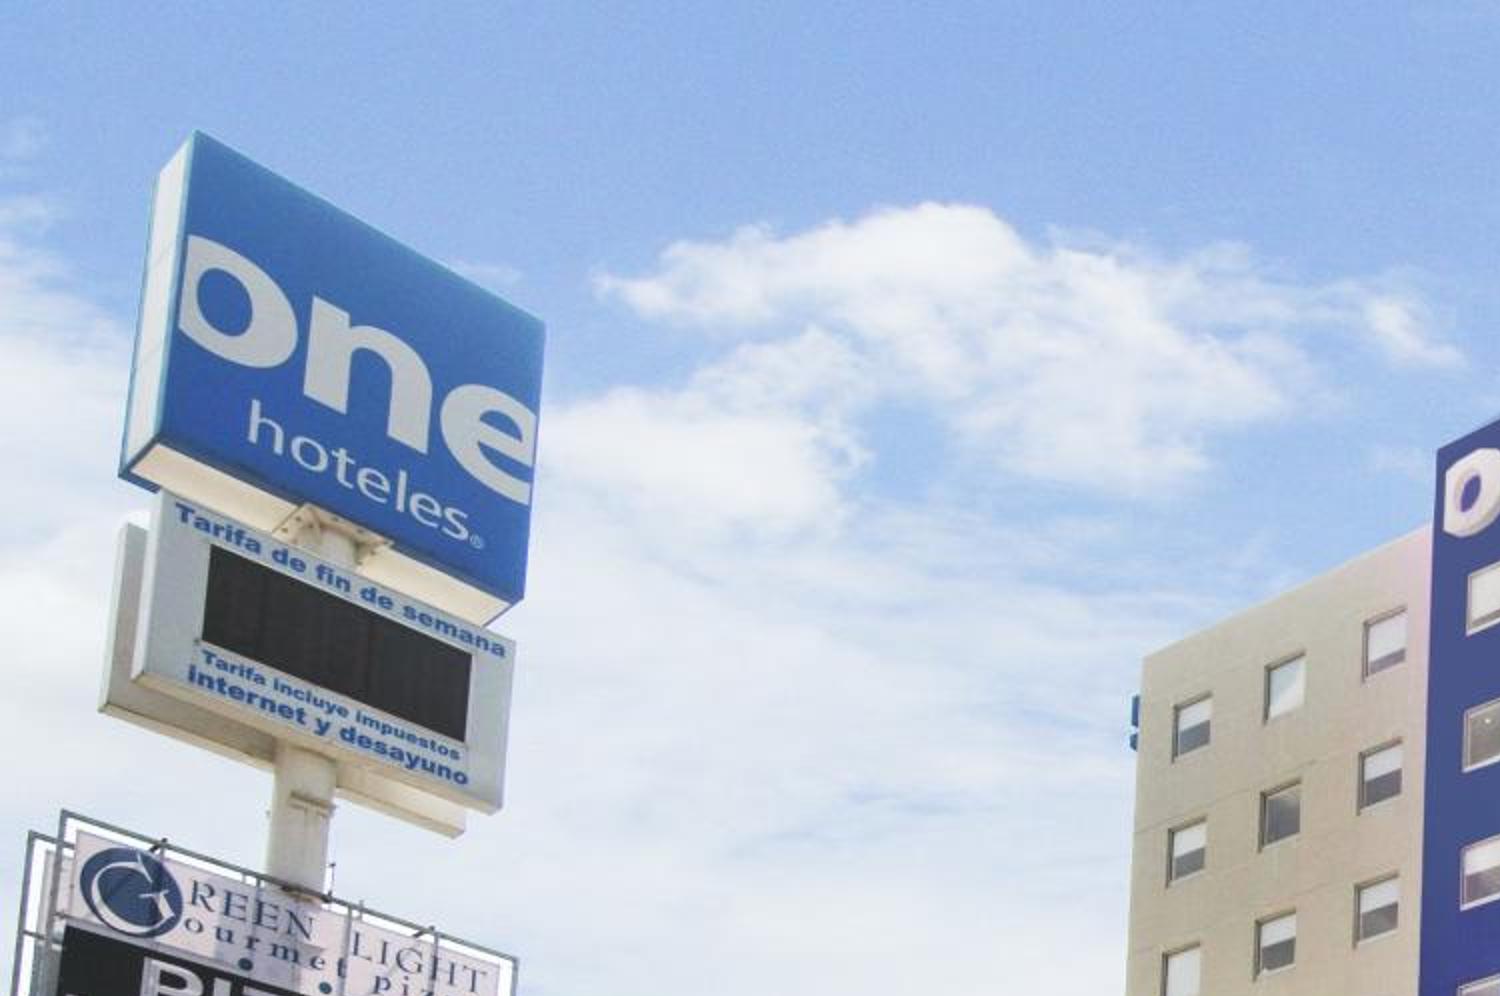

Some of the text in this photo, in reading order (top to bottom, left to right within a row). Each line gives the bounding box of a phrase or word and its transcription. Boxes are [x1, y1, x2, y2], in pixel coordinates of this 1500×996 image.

[178, 234, 537, 505] one
[175, 501, 506, 658] Tarifa de fin de semana
[187, 663, 469, 786] internet y desayuno
[202, 649, 266, 686] Tarifa
[350, 931, 488, 993] LIGHT
